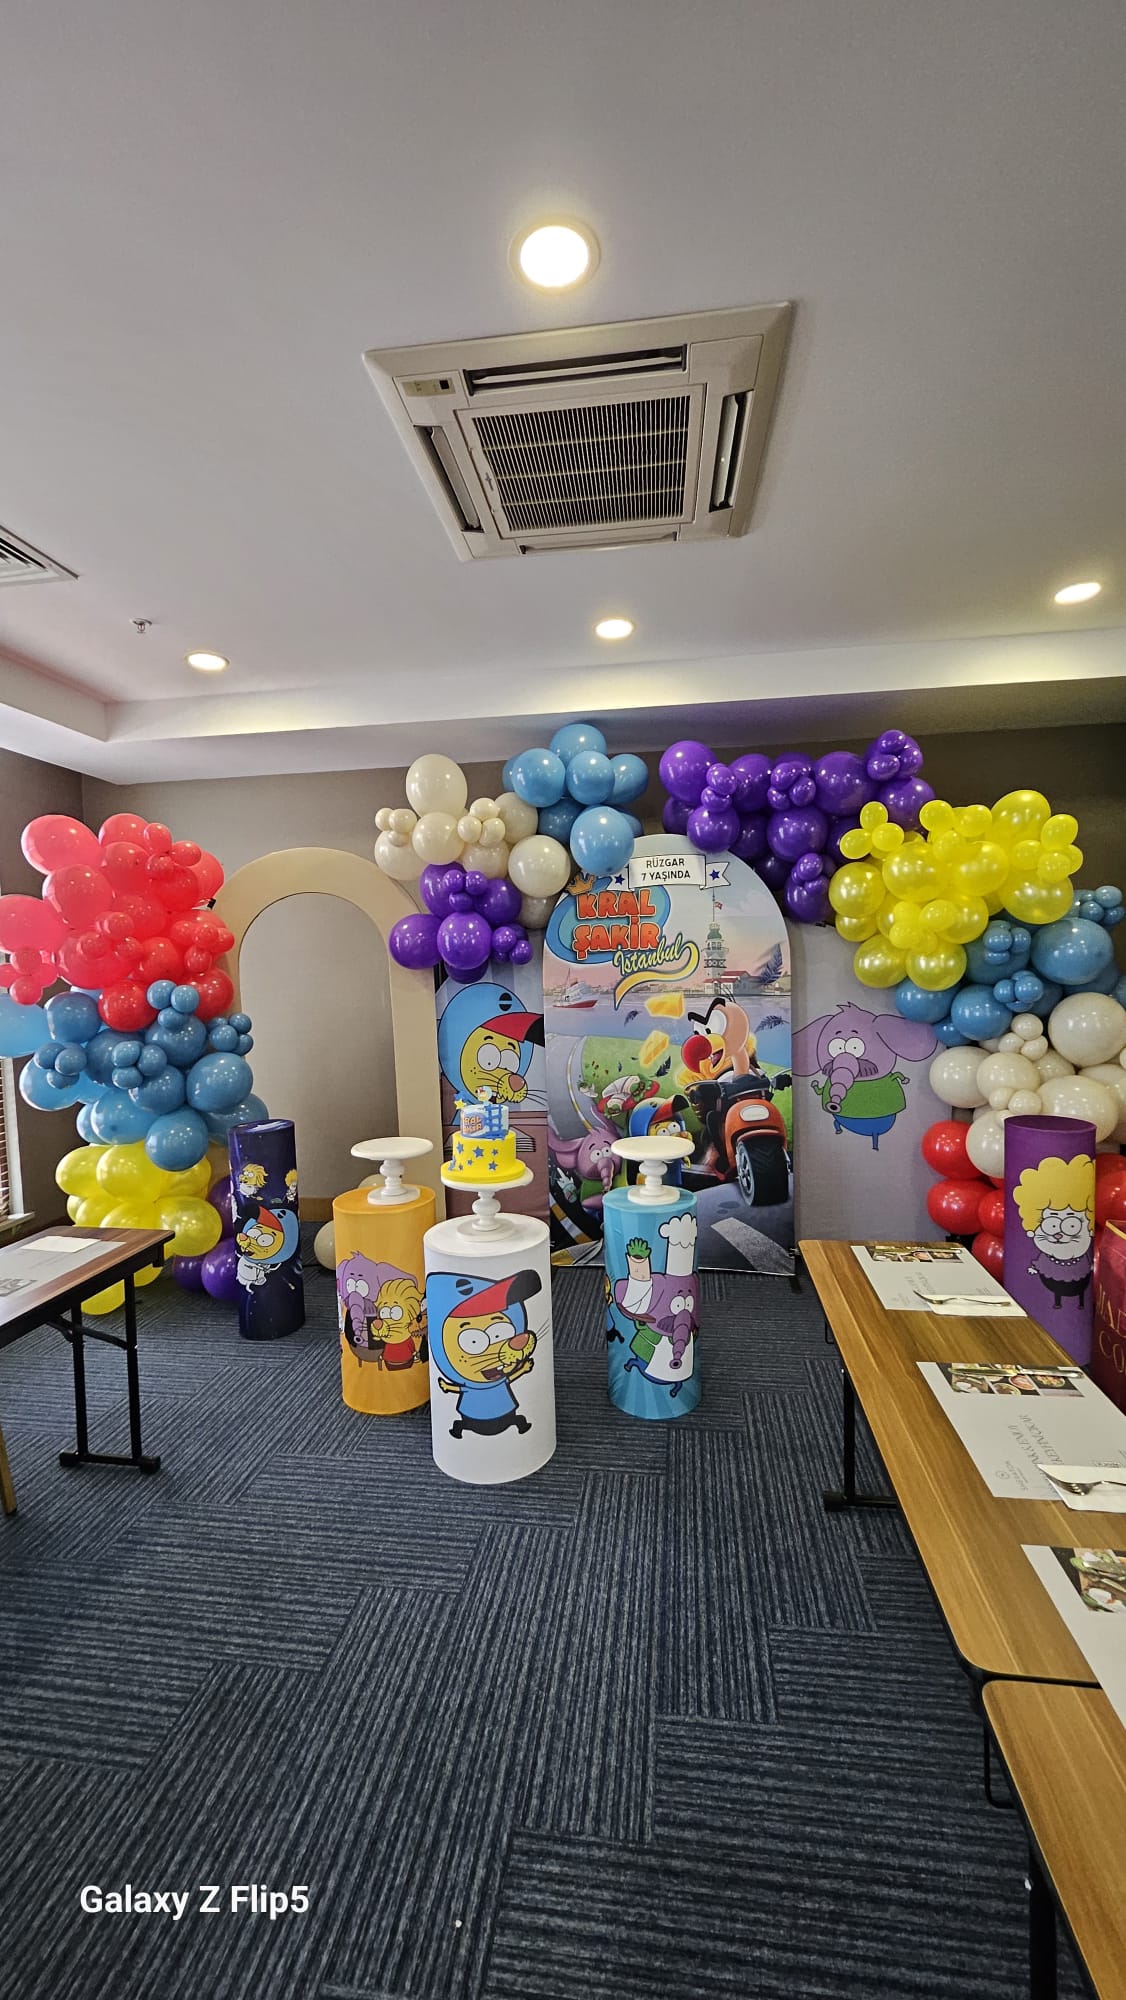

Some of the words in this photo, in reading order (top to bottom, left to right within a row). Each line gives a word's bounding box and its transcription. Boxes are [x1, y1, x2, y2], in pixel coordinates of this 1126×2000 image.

[645, 857, 686, 869] RÜZGAR
[641, 872, 647, 881] 7
[649, 870, 691, 882] YAŞINDA
[576, 889, 656, 920] KRAL
[573, 916, 662, 961] ŞAKİR
